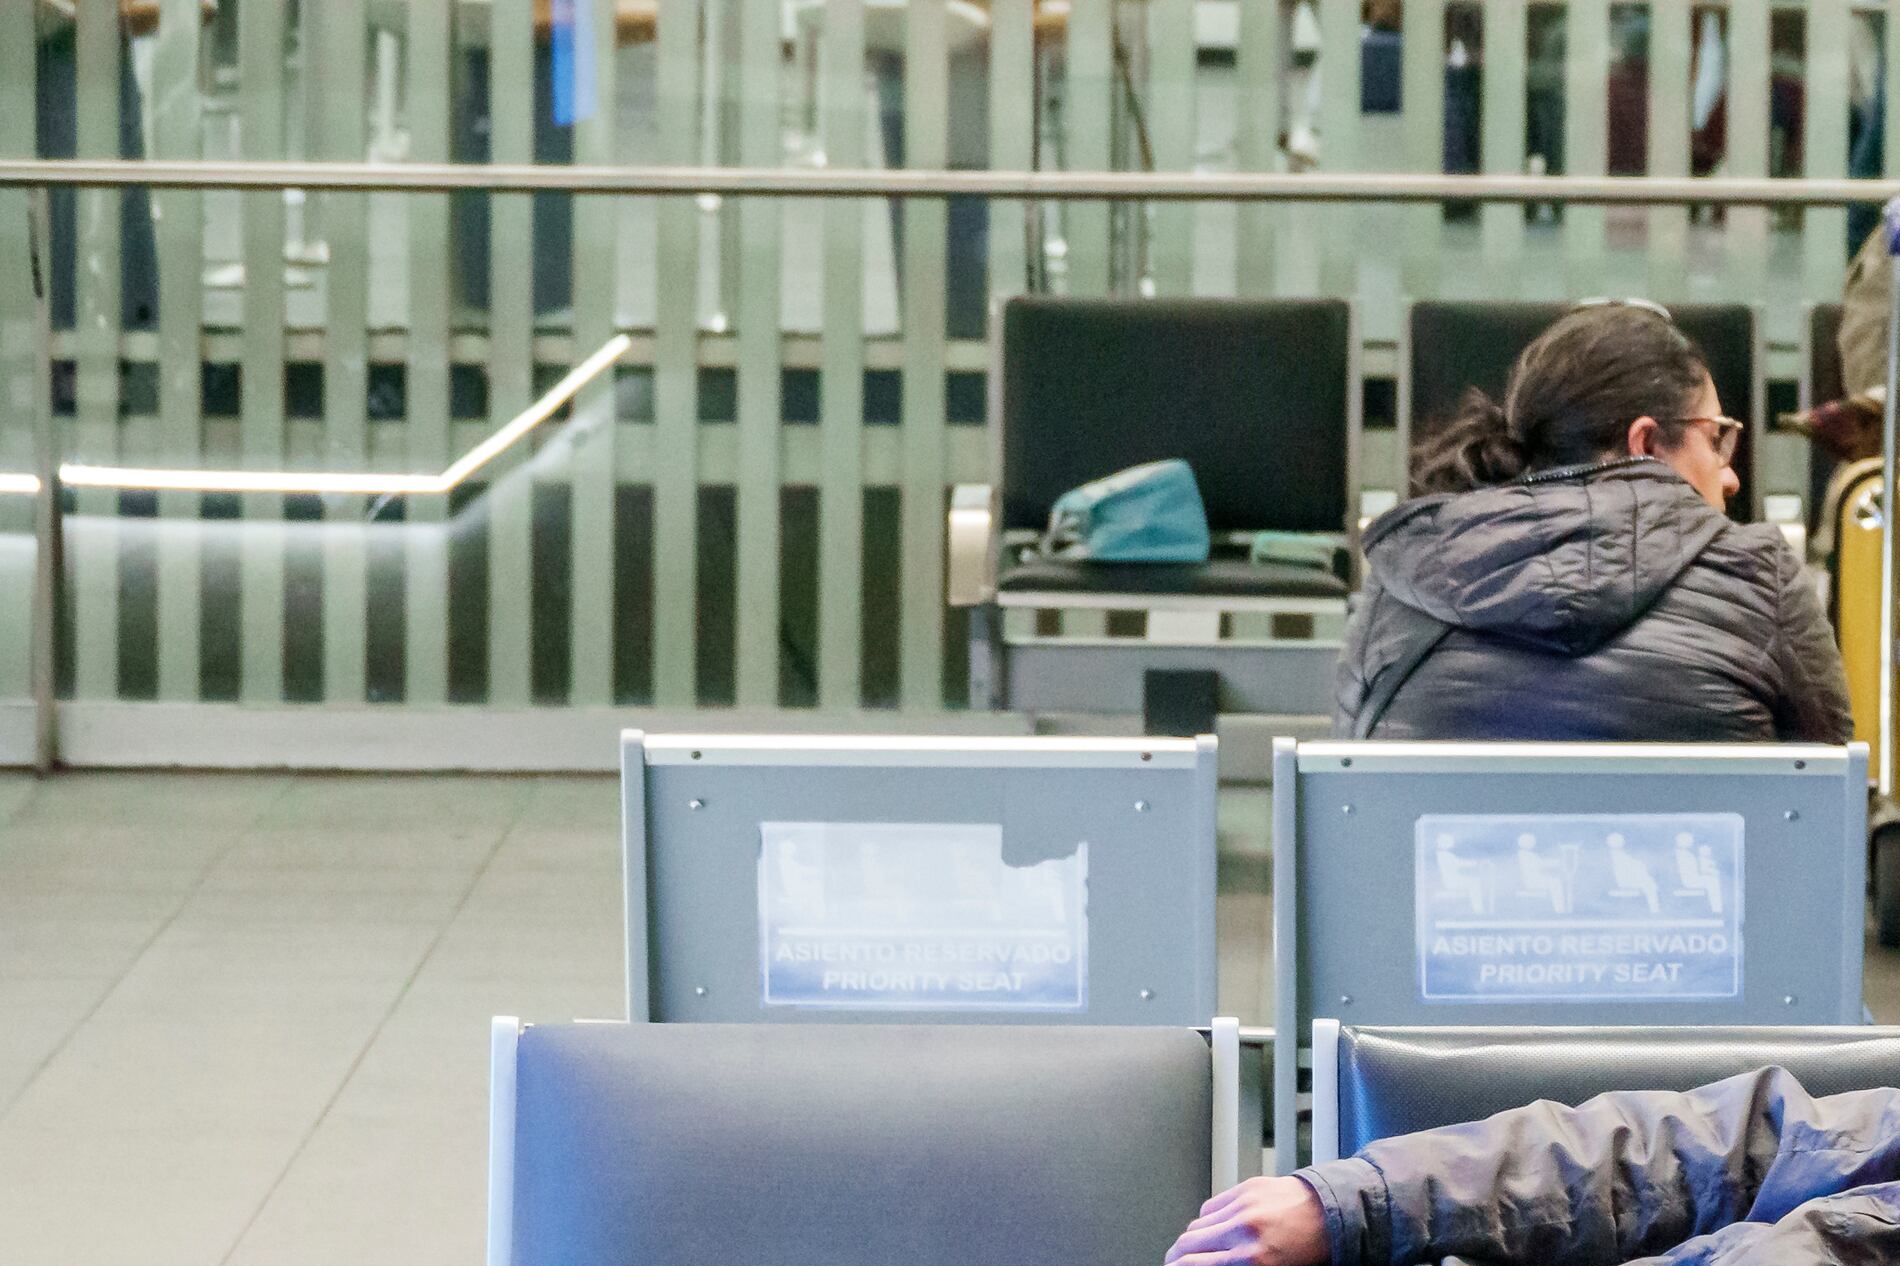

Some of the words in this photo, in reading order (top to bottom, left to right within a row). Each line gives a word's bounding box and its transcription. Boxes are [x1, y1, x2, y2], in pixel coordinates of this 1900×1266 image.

[775, 942, 896, 963] ASIENTO
[904, 942, 1071, 964] RESERVADO
[1432, 934, 1554, 955] ASIENTO
[1561, 933, 1728, 955] RESERVADO
[823, 970, 948, 991] PRIORITY
[957, 971, 1029, 991] SEAT
[1480, 963, 1606, 984] PRIORITY
[1613, 962, 1684, 983] SEAT
